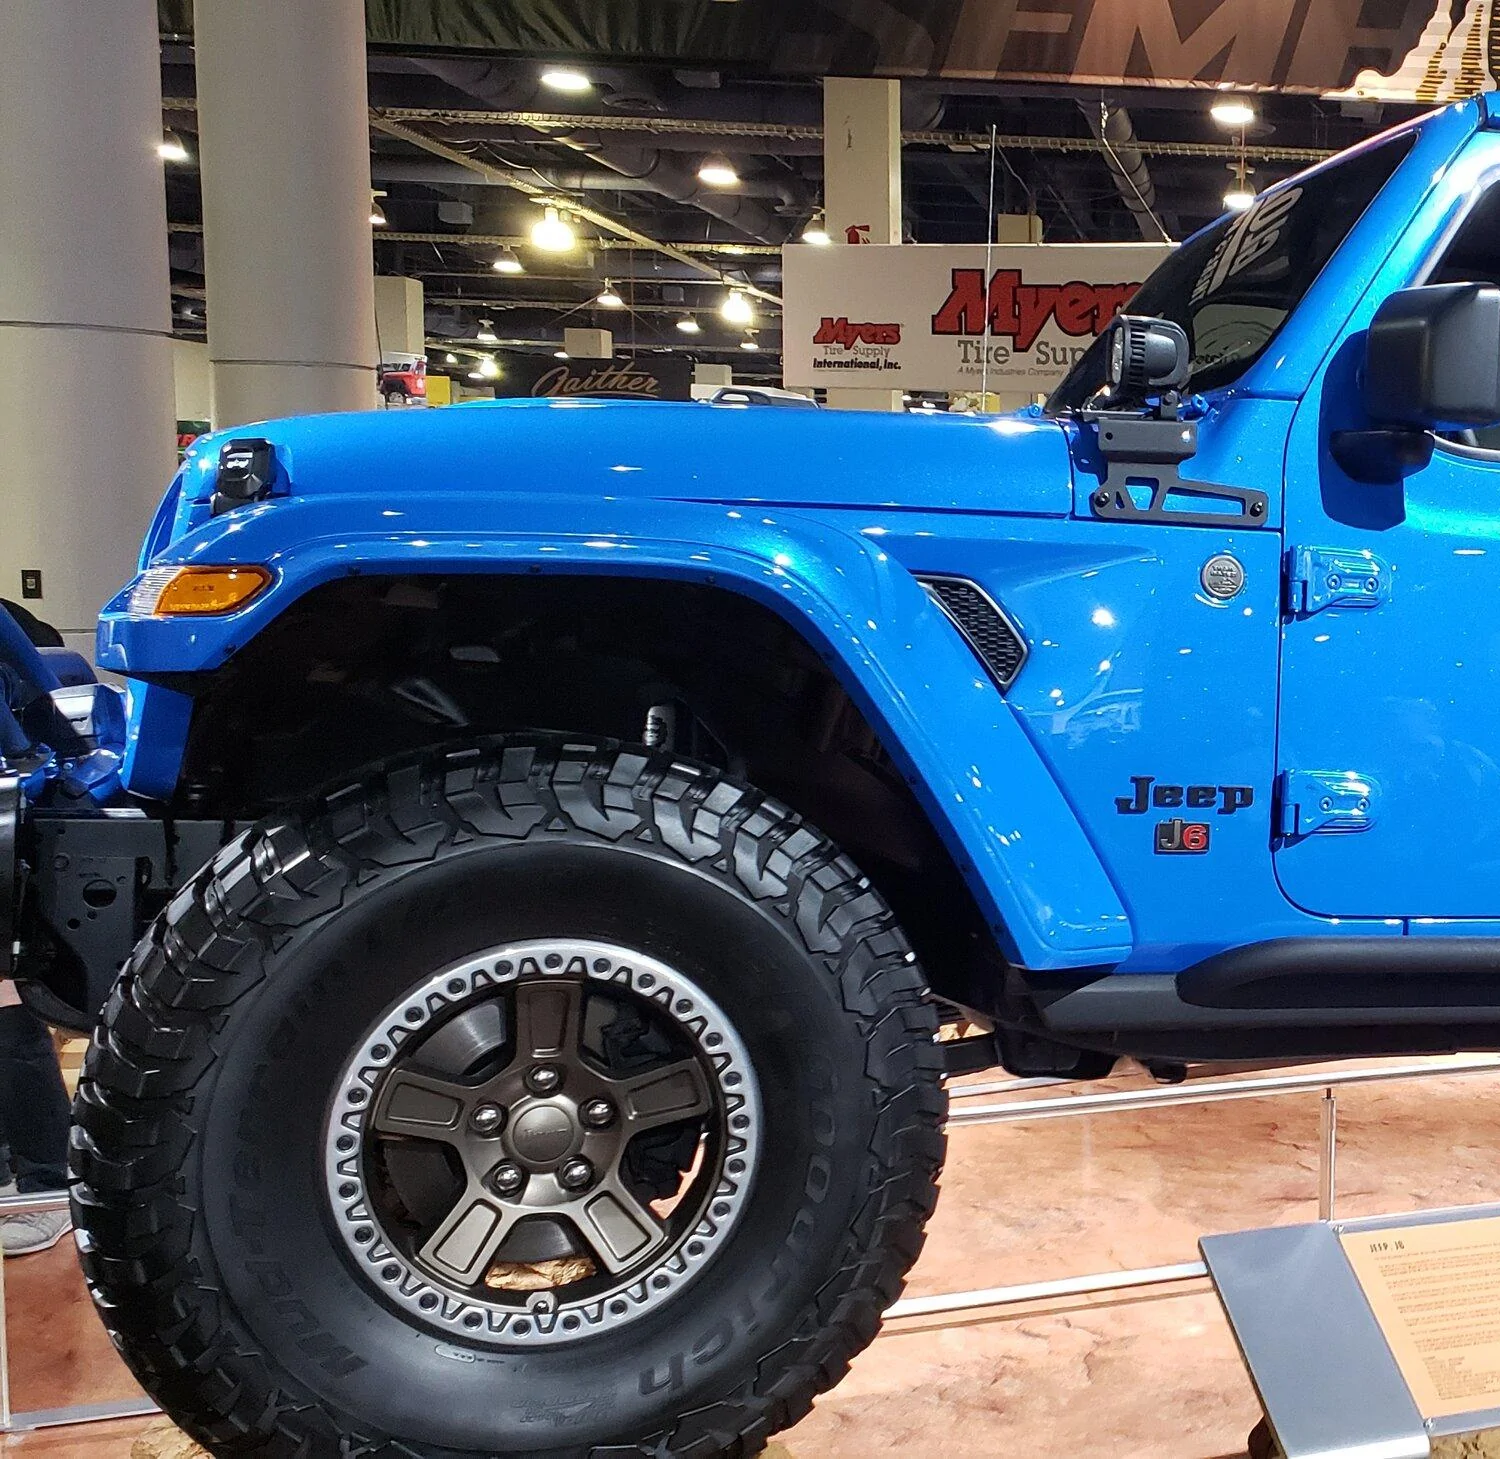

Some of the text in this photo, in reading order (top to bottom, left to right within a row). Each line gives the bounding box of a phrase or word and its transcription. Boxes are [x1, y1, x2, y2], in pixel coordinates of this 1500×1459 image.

[813, 317, 901, 350] Myers
[813, 358, 902, 371] International, Inc.
[823, 345, 891, 358] Tire Supply
[1035, 341, 1088, 366] Sup
[1115, 776, 1254, 815] Jeep
[1160, 818, 1208, 850] J6
